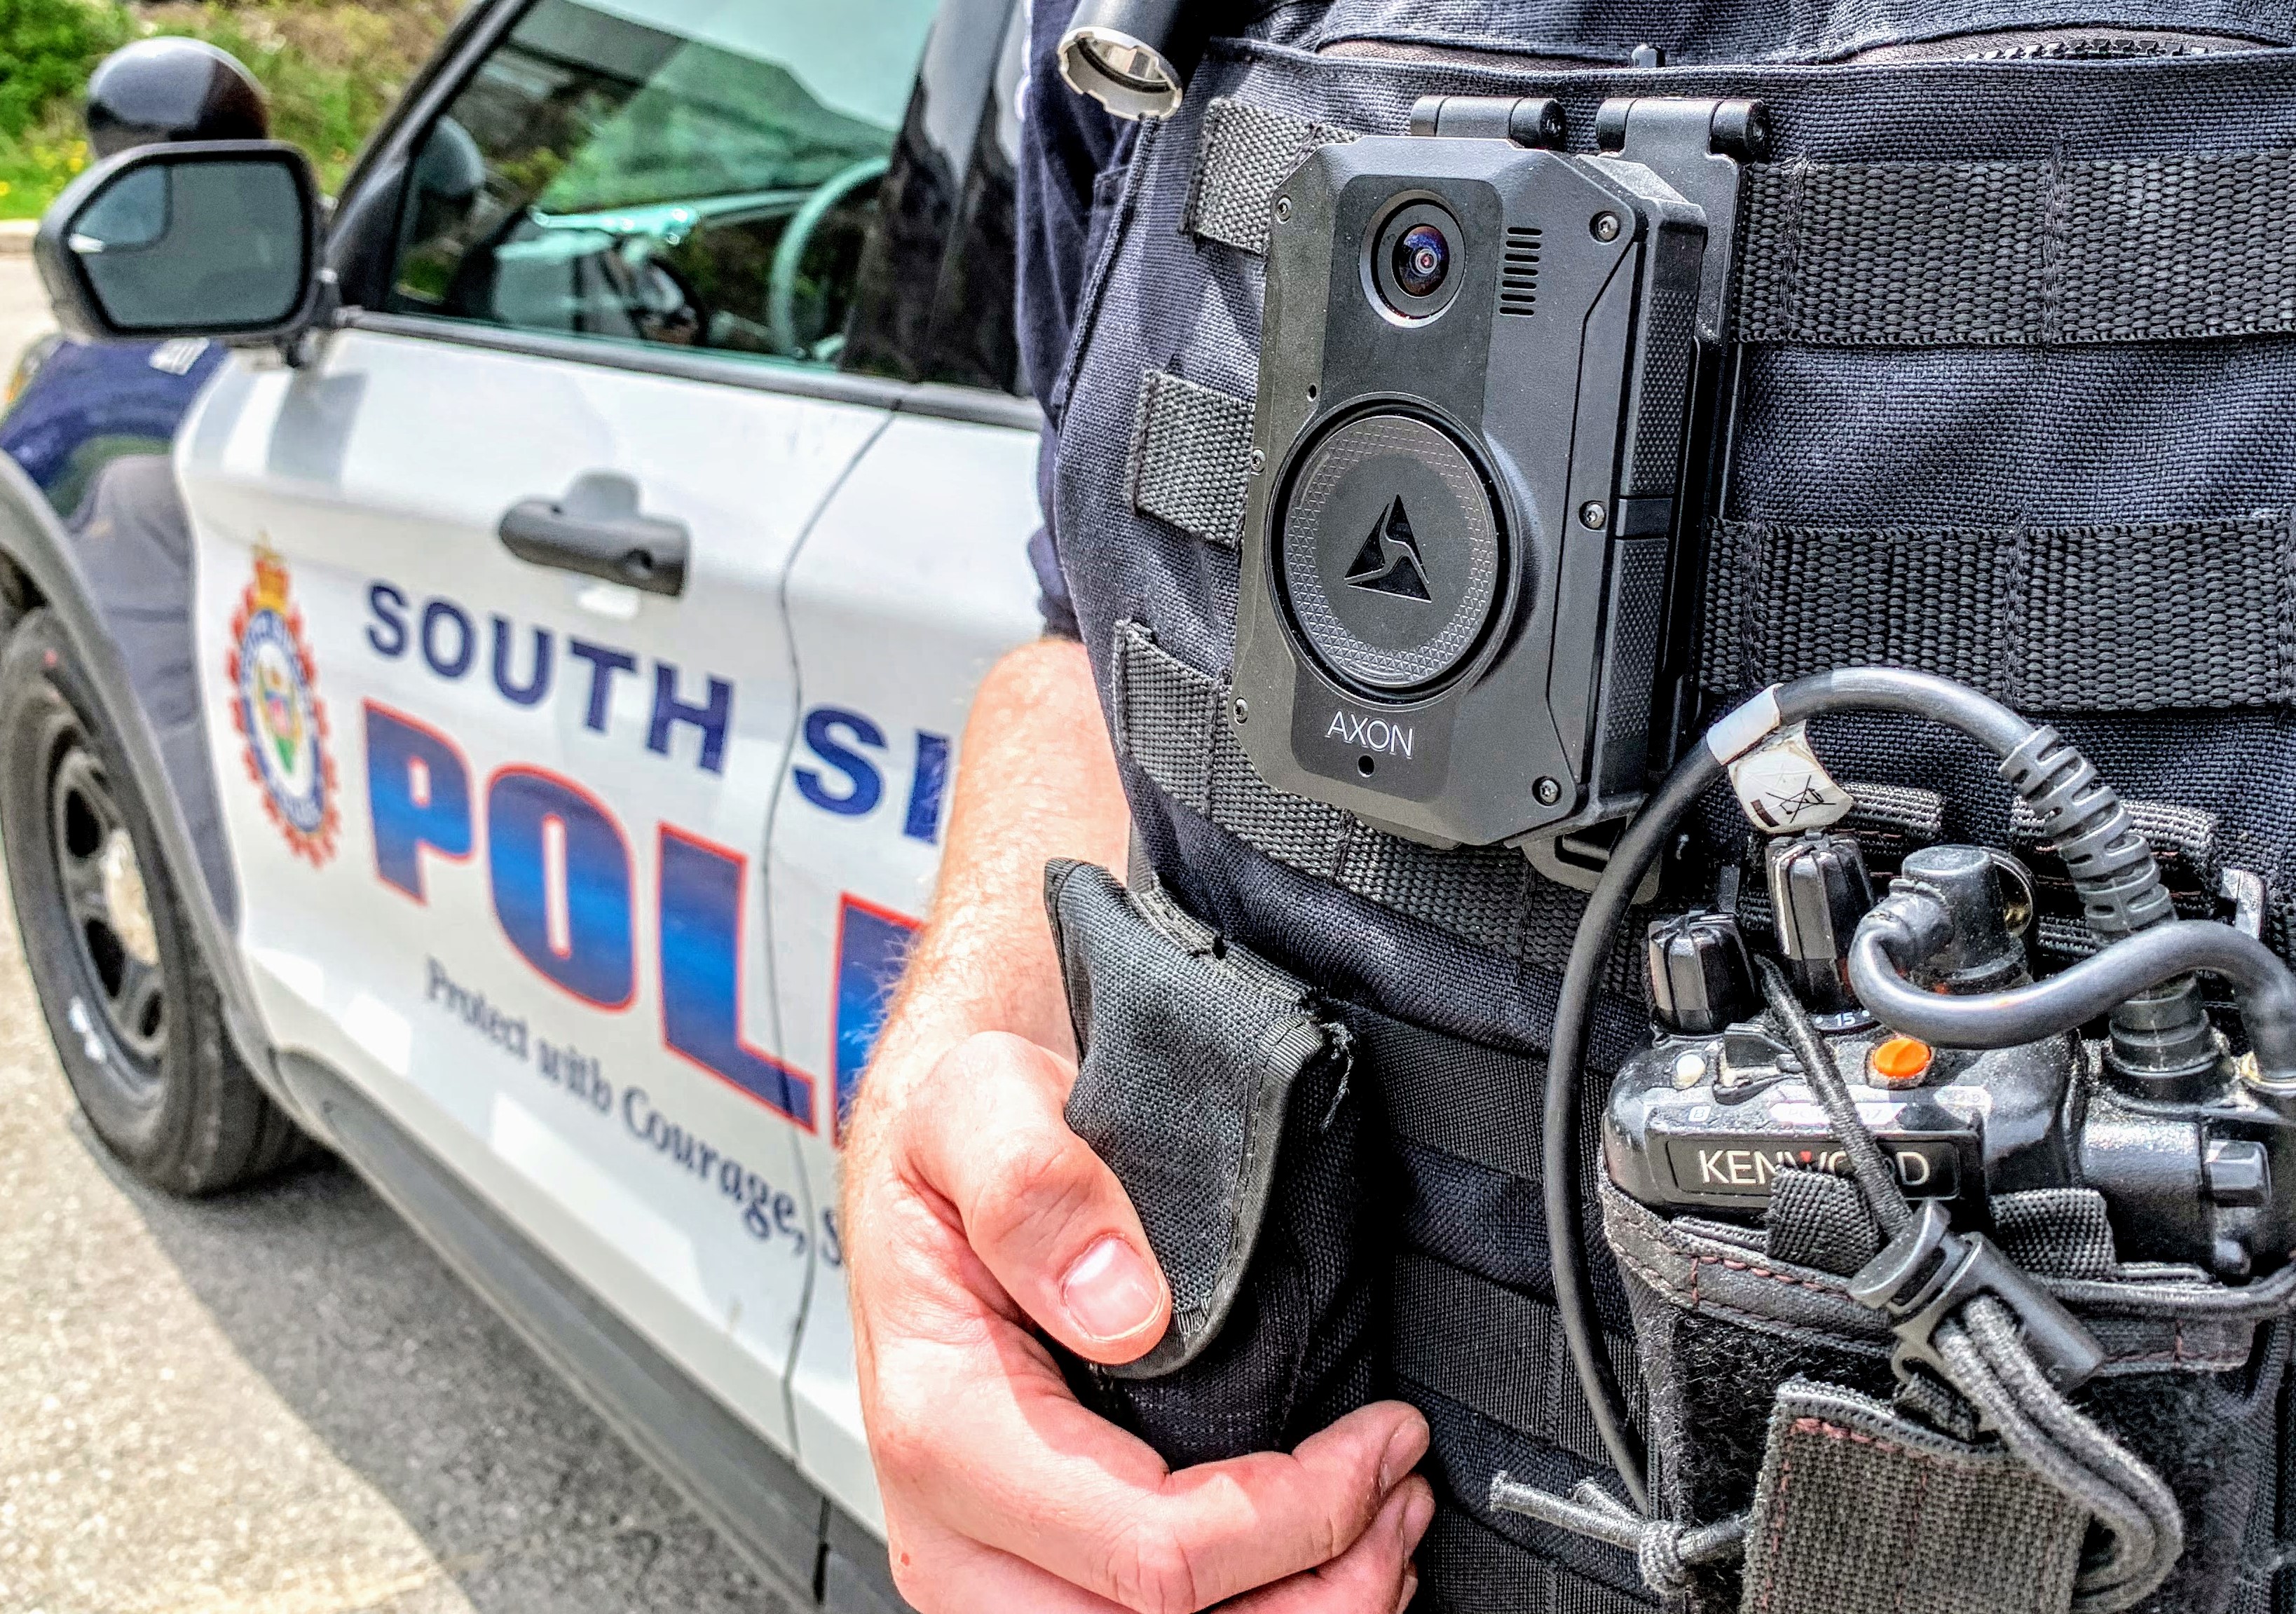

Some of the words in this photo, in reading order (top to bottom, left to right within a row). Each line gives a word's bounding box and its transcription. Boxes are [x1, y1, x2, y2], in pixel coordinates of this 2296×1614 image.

[367, 579, 732, 776] SOUTH
[1325, 710, 1413, 759] AXON
[1835, 1011, 1856, 1027] 15
[535, 1037, 612, 1114] with
[622, 1085, 805, 1256] Courage,
